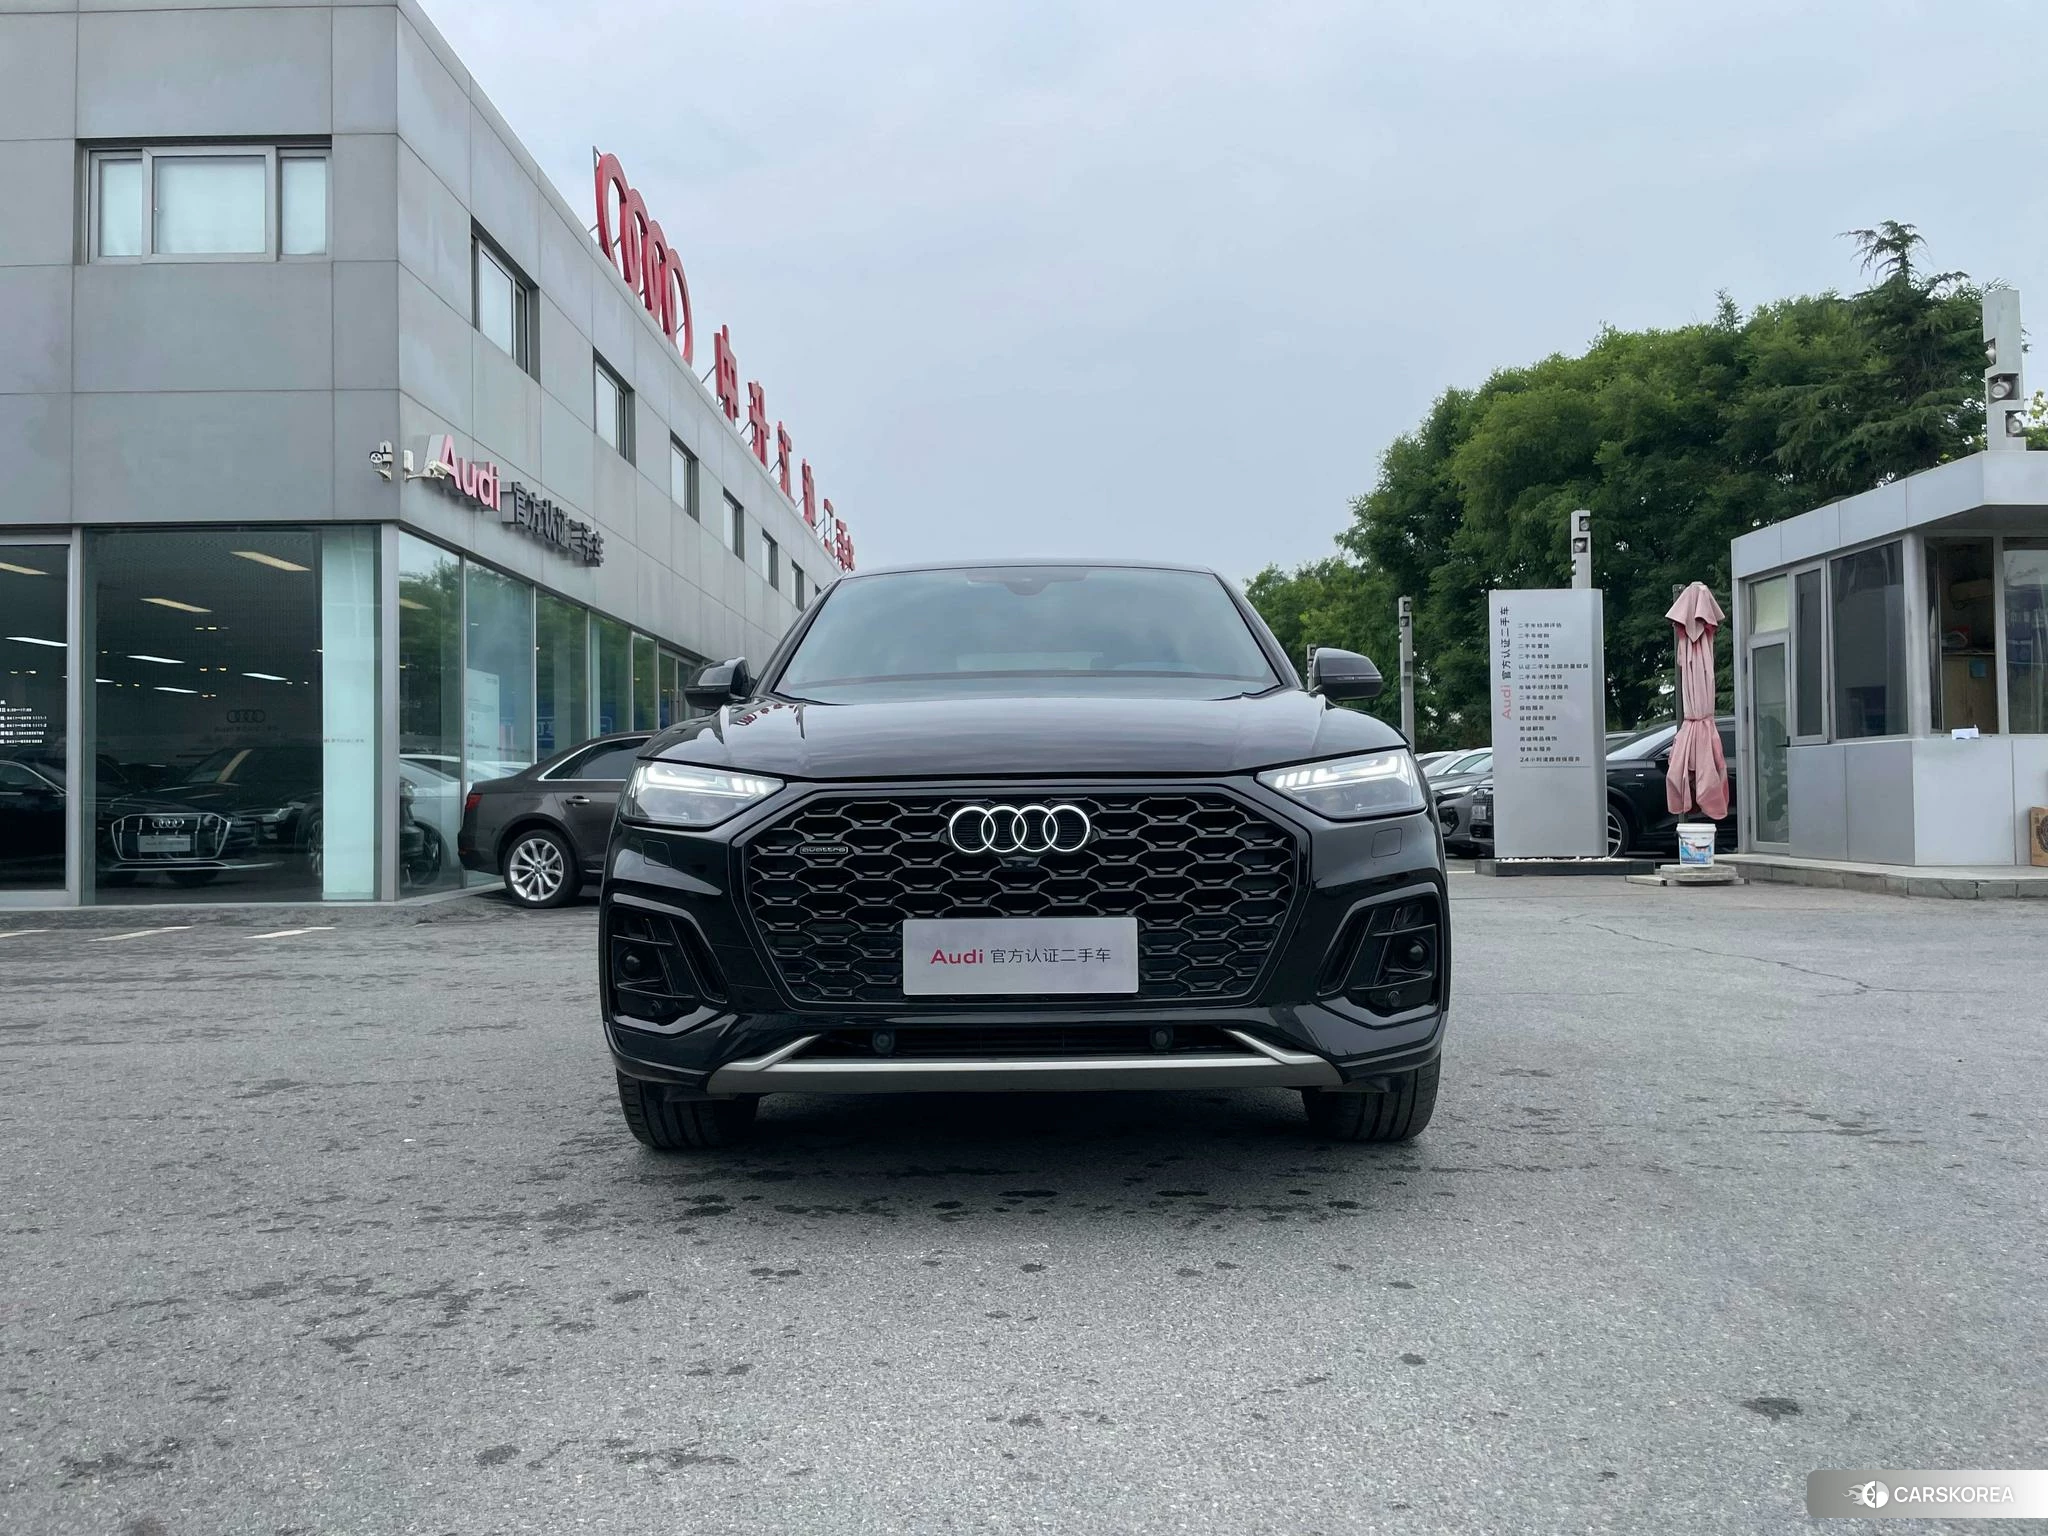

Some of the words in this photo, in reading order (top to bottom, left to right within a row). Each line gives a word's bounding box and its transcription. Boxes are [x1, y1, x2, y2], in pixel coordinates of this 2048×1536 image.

[433, 434, 500, 512] Audi
[1500, 605, 1512, 680] 官方认证二手车
[1501, 684, 1512, 720] Audi
[930, 948, 984, 964] Audi
[990, 948, 1112, 964] 官方认证二手车
